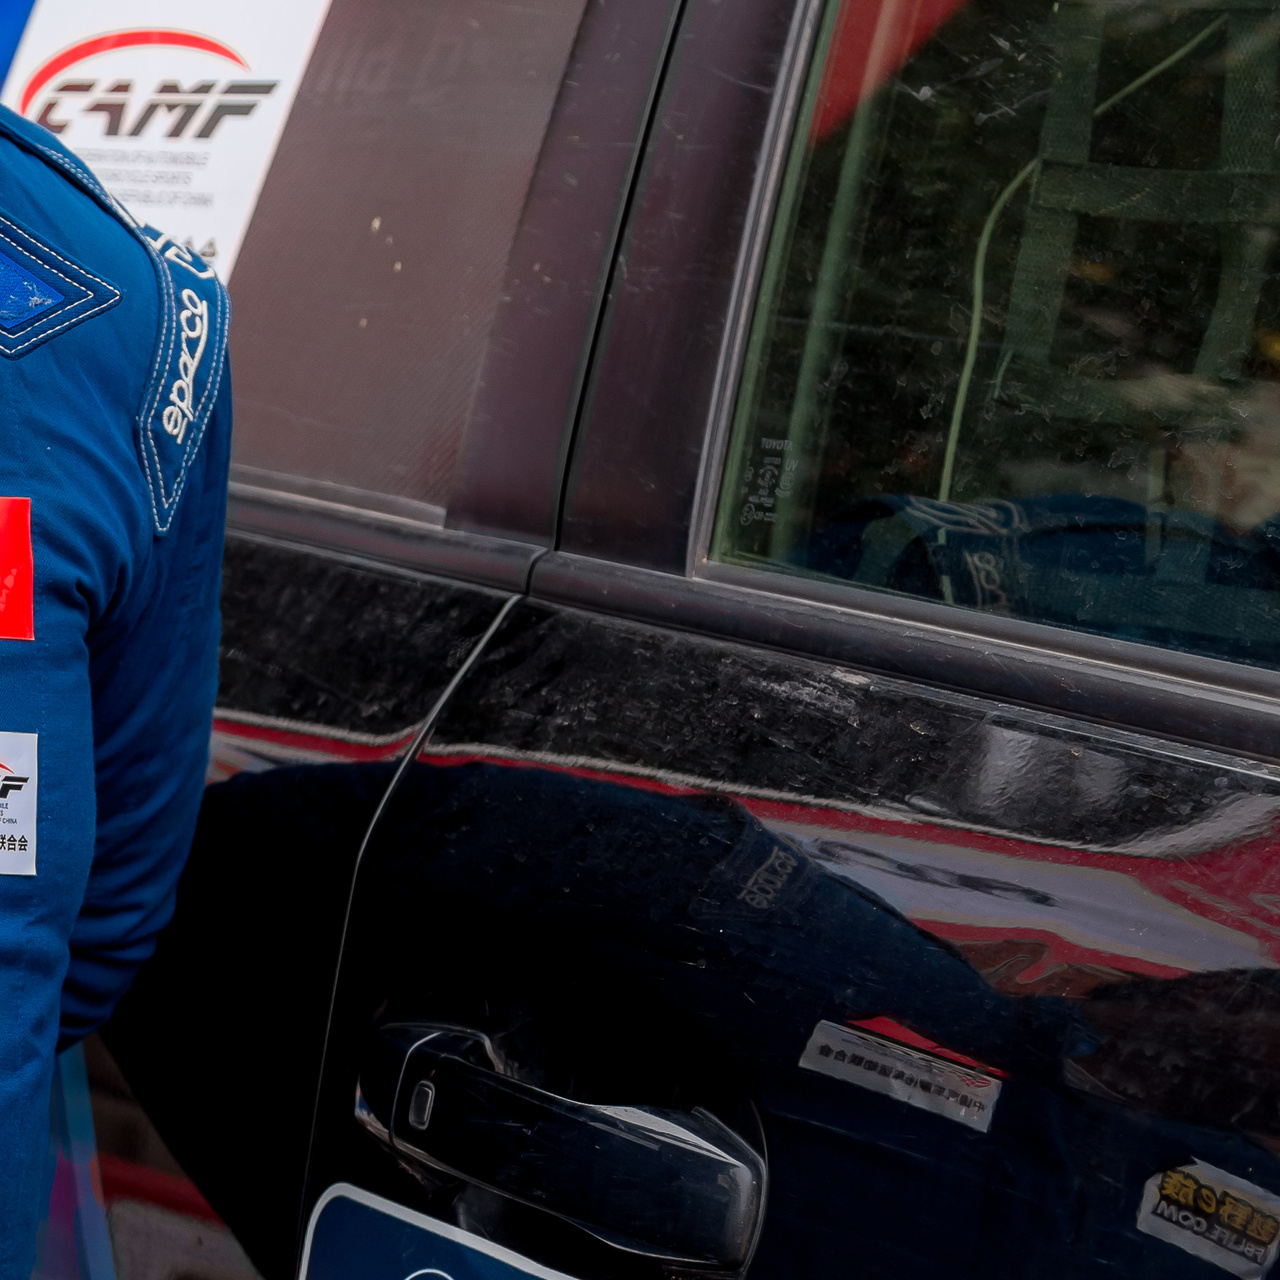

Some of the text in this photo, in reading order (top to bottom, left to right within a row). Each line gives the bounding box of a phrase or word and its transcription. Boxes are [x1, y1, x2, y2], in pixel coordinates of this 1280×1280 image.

[35, 80, 279, 140] CAMF
[162, 288, 209, 445] sparco
[761, 437, 793, 451] TOYOTA
[2, 817, 18, 825] CHINA
